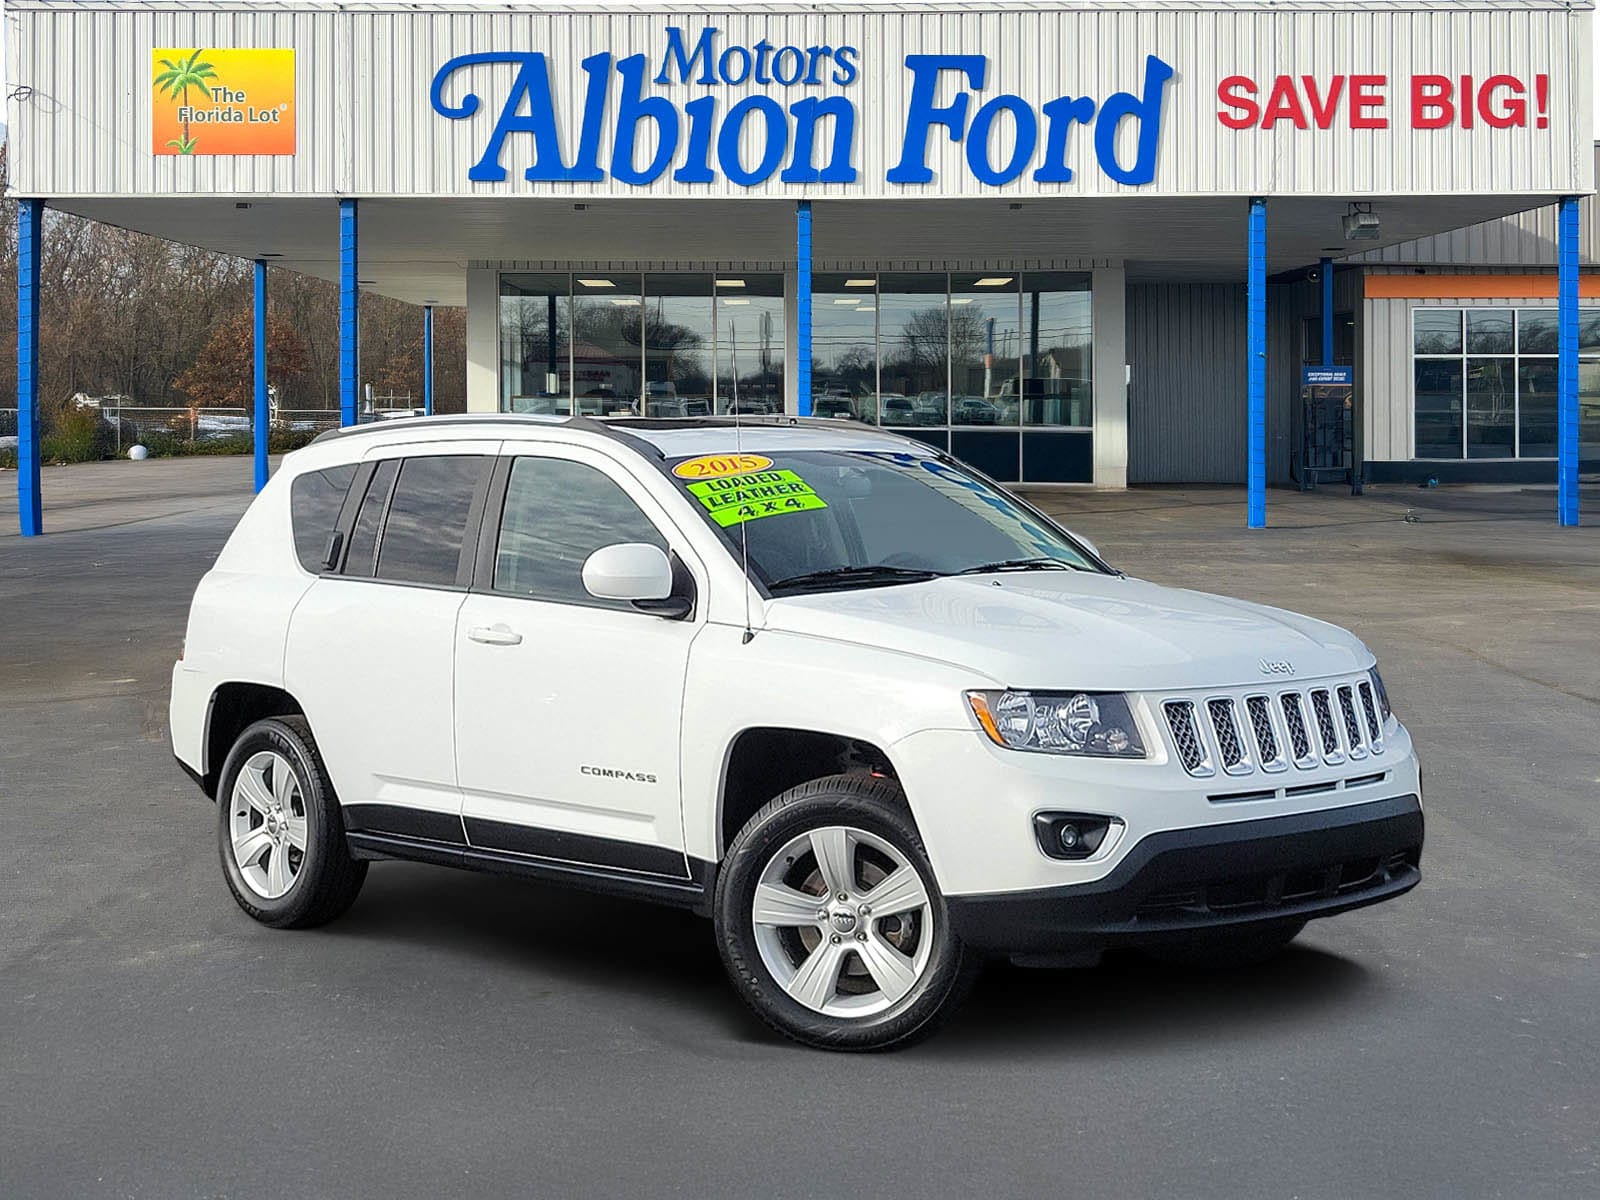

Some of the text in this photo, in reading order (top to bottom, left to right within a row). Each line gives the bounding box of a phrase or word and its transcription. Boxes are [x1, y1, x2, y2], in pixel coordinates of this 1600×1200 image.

[654, 27, 857, 85] Motors
[210, 86, 245, 103] The
[1218, 75, 1549, 129] SAVE BIG!
[178, 106, 279, 122] Florida Lot
[430, 52, 1175, 186] Albion Ford
[690, 456, 758, 476] 2015
[706, 472, 784, 491] LOADED
[707, 482, 805, 507] LEATHER
[1258, 656, 1296, 676] Jeep
[580, 765, 657, 784] COMPASS
